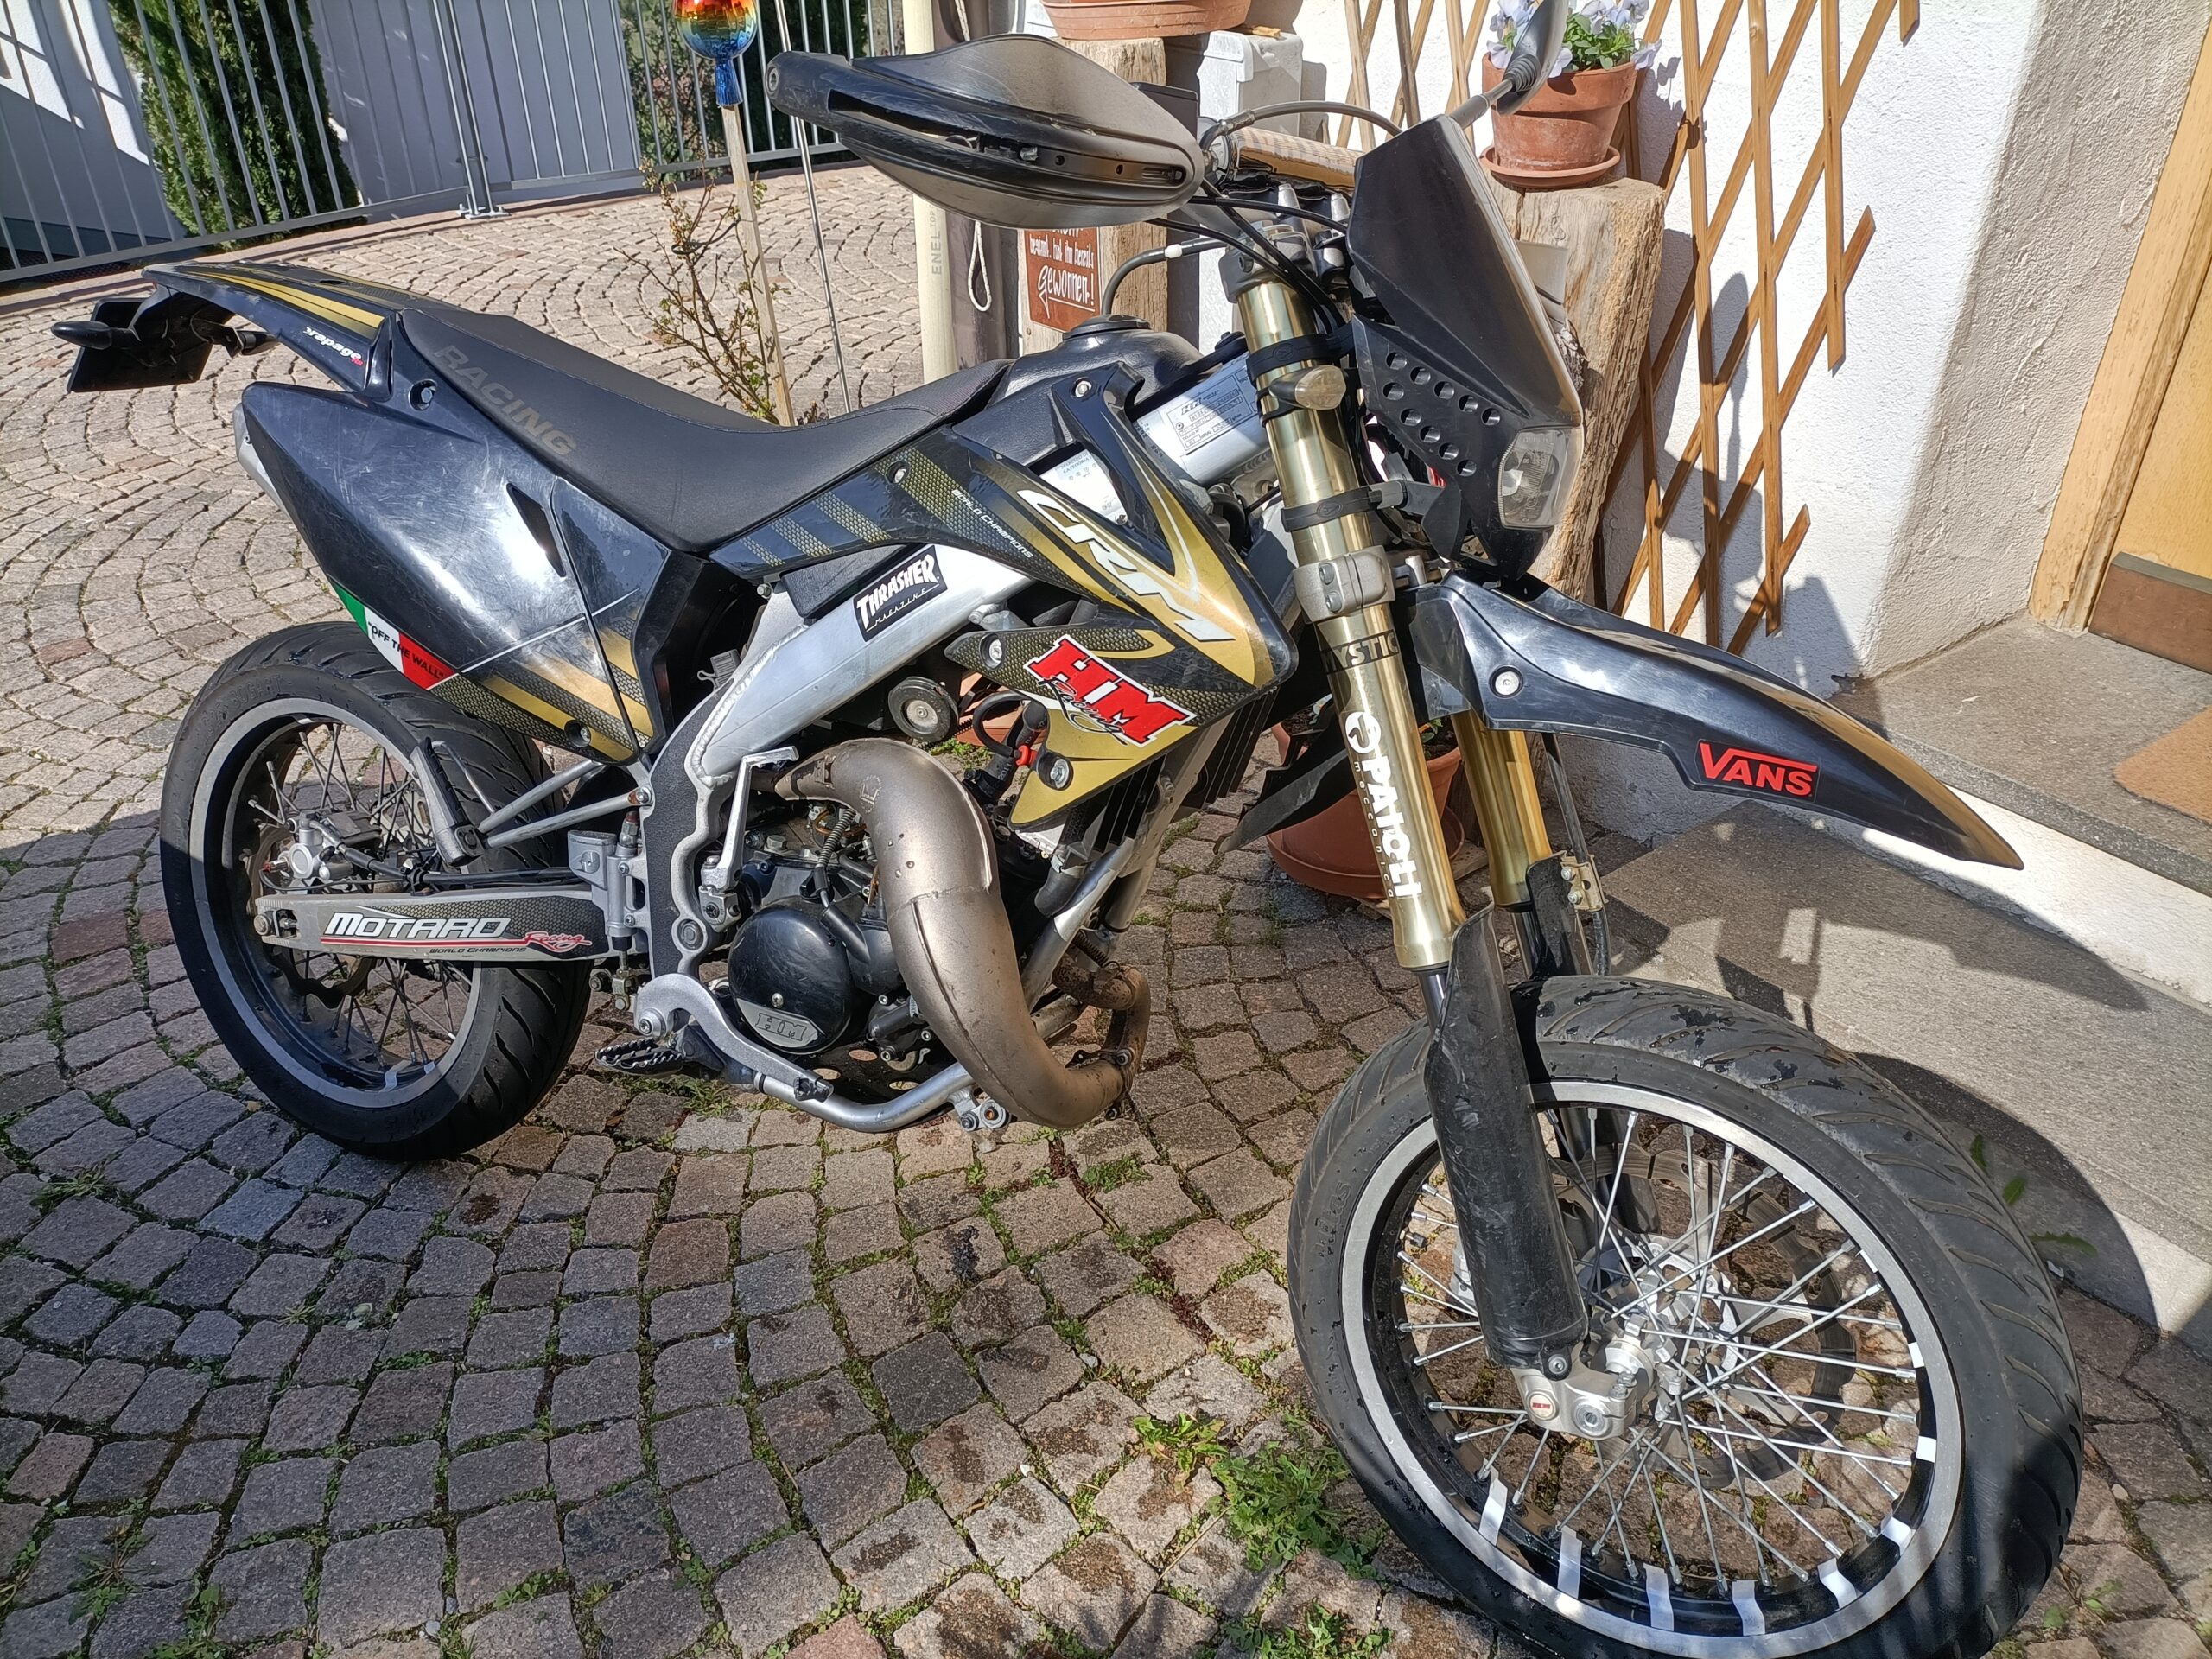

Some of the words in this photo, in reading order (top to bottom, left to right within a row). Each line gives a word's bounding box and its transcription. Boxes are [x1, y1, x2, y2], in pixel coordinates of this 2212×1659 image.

[931, 230, 943, 276] ENEL
[434, 345, 577, 456] RACING
[951, 489, 982, 516] WORLD
[980, 514, 1034, 559] CHAMPIONS
[856, 553, 939, 630] THRASHER
[391, 639, 410, 658] THE
[1321, 631, 1400, 672] MYSTIC
[1026, 635, 1194, 746] HM
[1699, 741, 1818, 797] VANS
[1353, 760, 1395, 899] meccanica
[323, 912, 512, 939] MOTARD
[754, 1012, 807, 1042] HM
